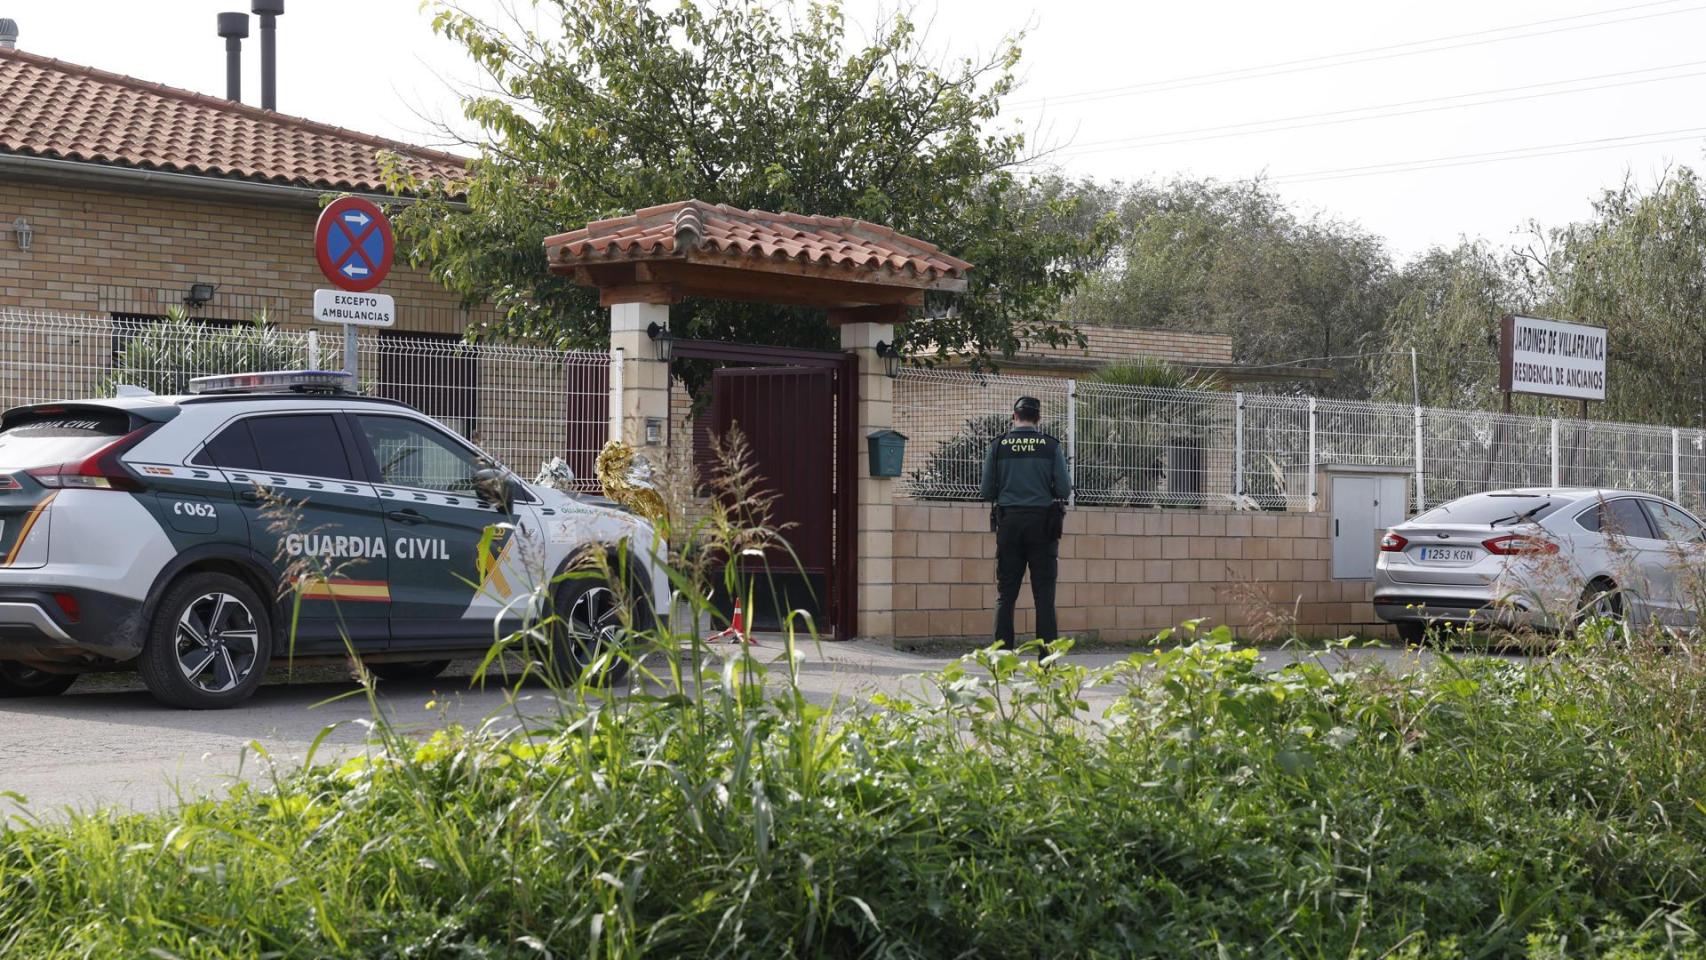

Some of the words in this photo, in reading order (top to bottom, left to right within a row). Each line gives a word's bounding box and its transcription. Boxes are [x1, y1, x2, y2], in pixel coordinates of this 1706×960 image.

[335, 295, 377, 307] EXCEPTO
[322, 308, 390, 322] AMBULANCIAS
[1514, 326, 1547, 354] JARDINES
[1547, 330, 1557, 355] DE
[1558, 331, 1604, 361] VILLAFRANCA
[1513, 361, 1554, 385] RESIDENCIA
[1555, 367, 1564, 386] DE
[1566, 368, 1603, 390] ANCIANOS
[63, 420, 101, 430] CIVIL
[1001, 438, 1046, 446] GUARDIA
[1011, 444, 1036, 452] CIVIL
[285, 533, 387, 559] GUARDIA
[395, 537, 450, 560] CIVIL
[1427, 549, 1451, 560] 1253
[1453, 550, 1474, 561] KGN
